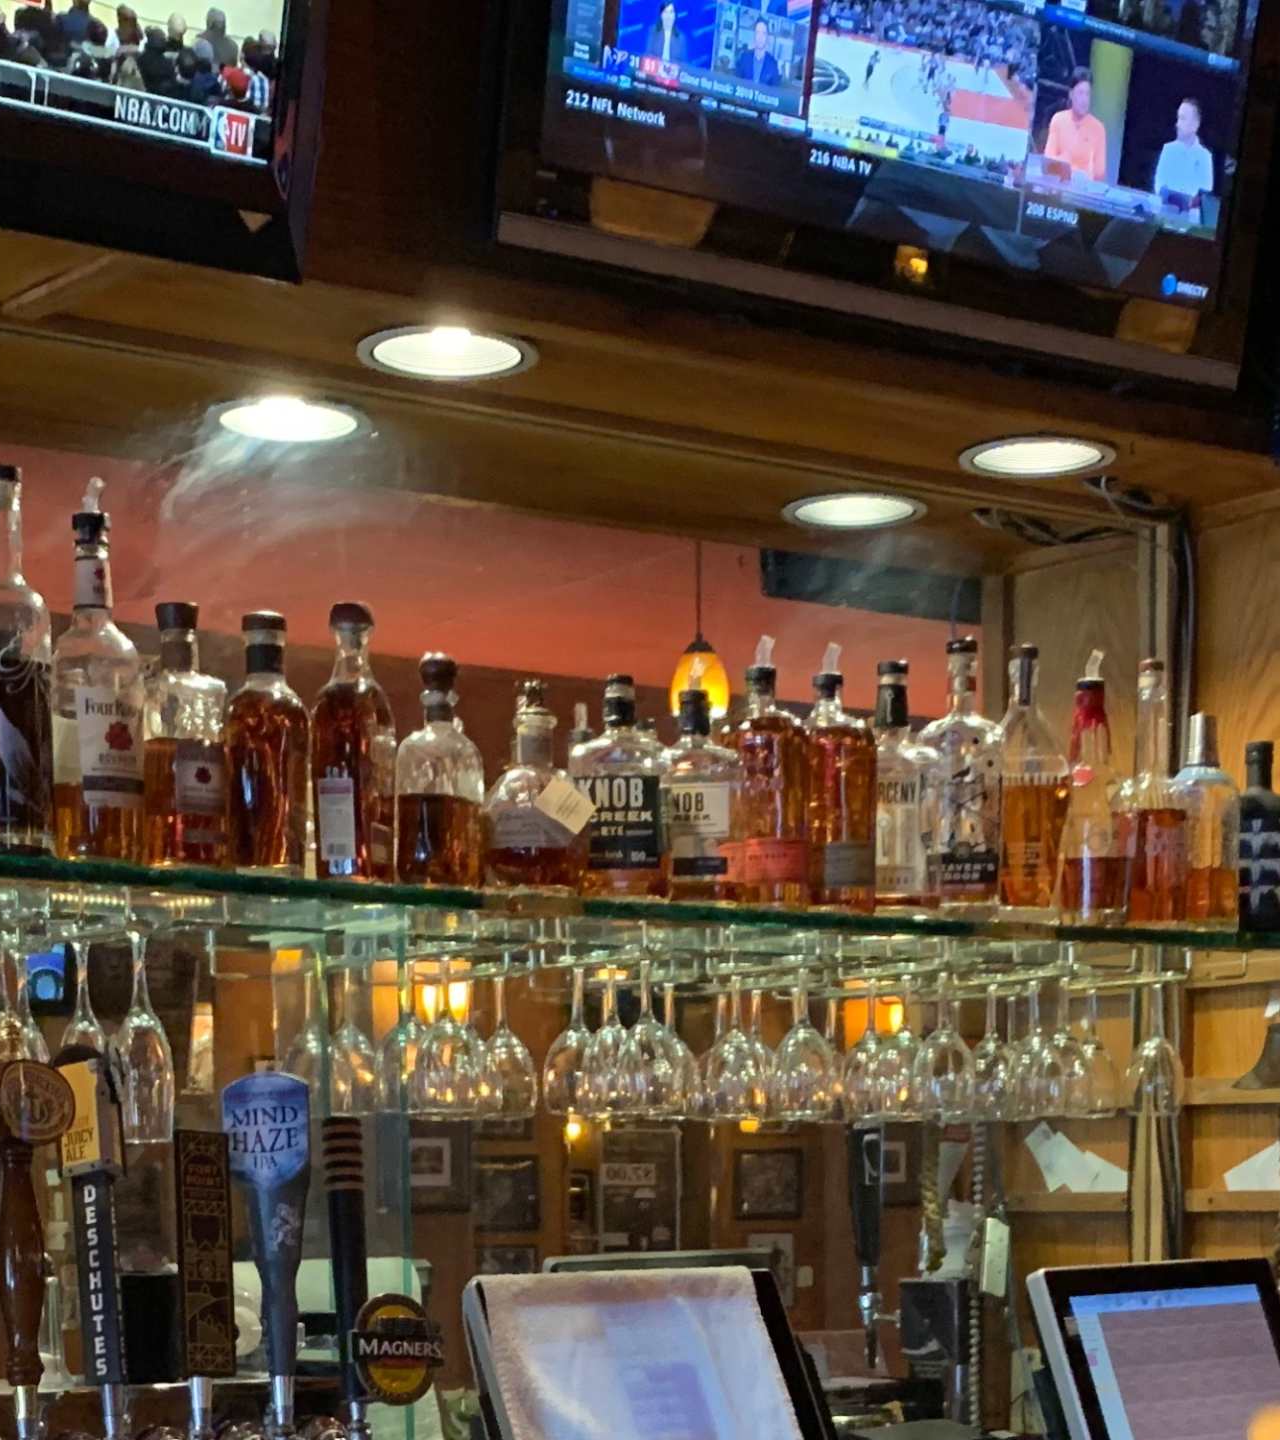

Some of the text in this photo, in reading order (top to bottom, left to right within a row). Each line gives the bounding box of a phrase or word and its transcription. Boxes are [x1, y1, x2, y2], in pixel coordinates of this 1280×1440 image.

[114, 95, 206, 139] NBA.COM
[566, 89, 666, 128] 212 NFL Network
[810, 149, 873, 177] 216 NBA TV
[231, 1106, 299, 1128] MIND
[231, 1128, 300, 1153] HAZE
[253, 1155, 279, 1169] IPA
[83, 1184, 109, 1377] DESCHUTES
[359, 1338, 443, 1359] MAGNERS
